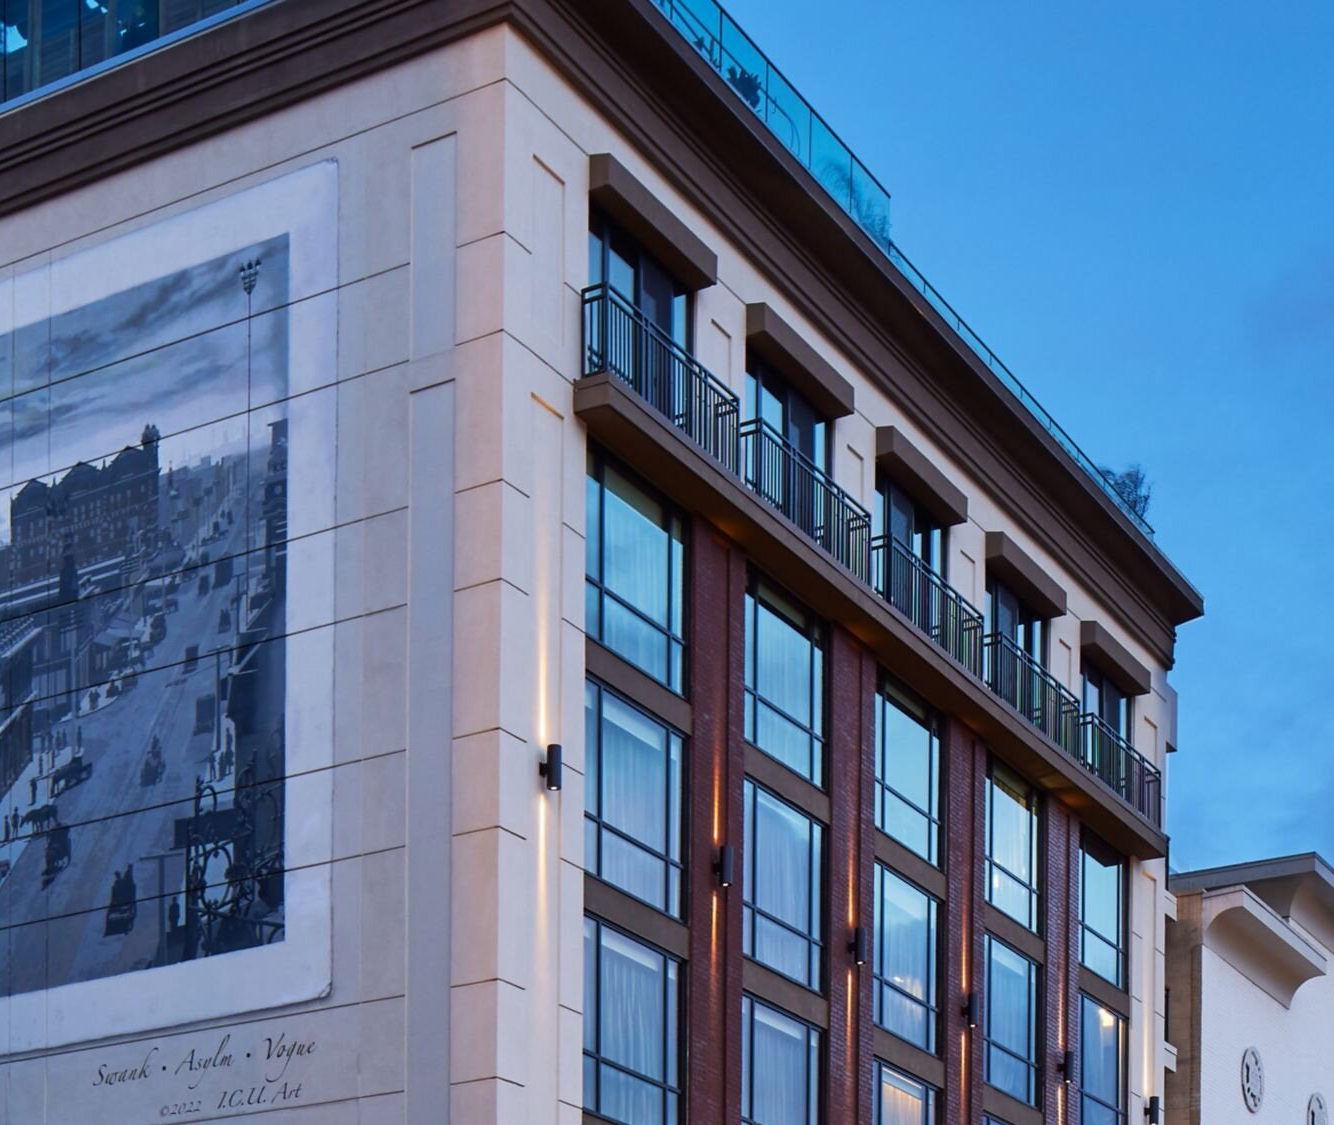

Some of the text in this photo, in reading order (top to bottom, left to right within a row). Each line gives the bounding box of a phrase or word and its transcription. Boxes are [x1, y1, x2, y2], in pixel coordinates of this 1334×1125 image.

[92, 1033, 316, 1089] Swank Asylm Vogue
[271, 1081, 303, 1103] Art
